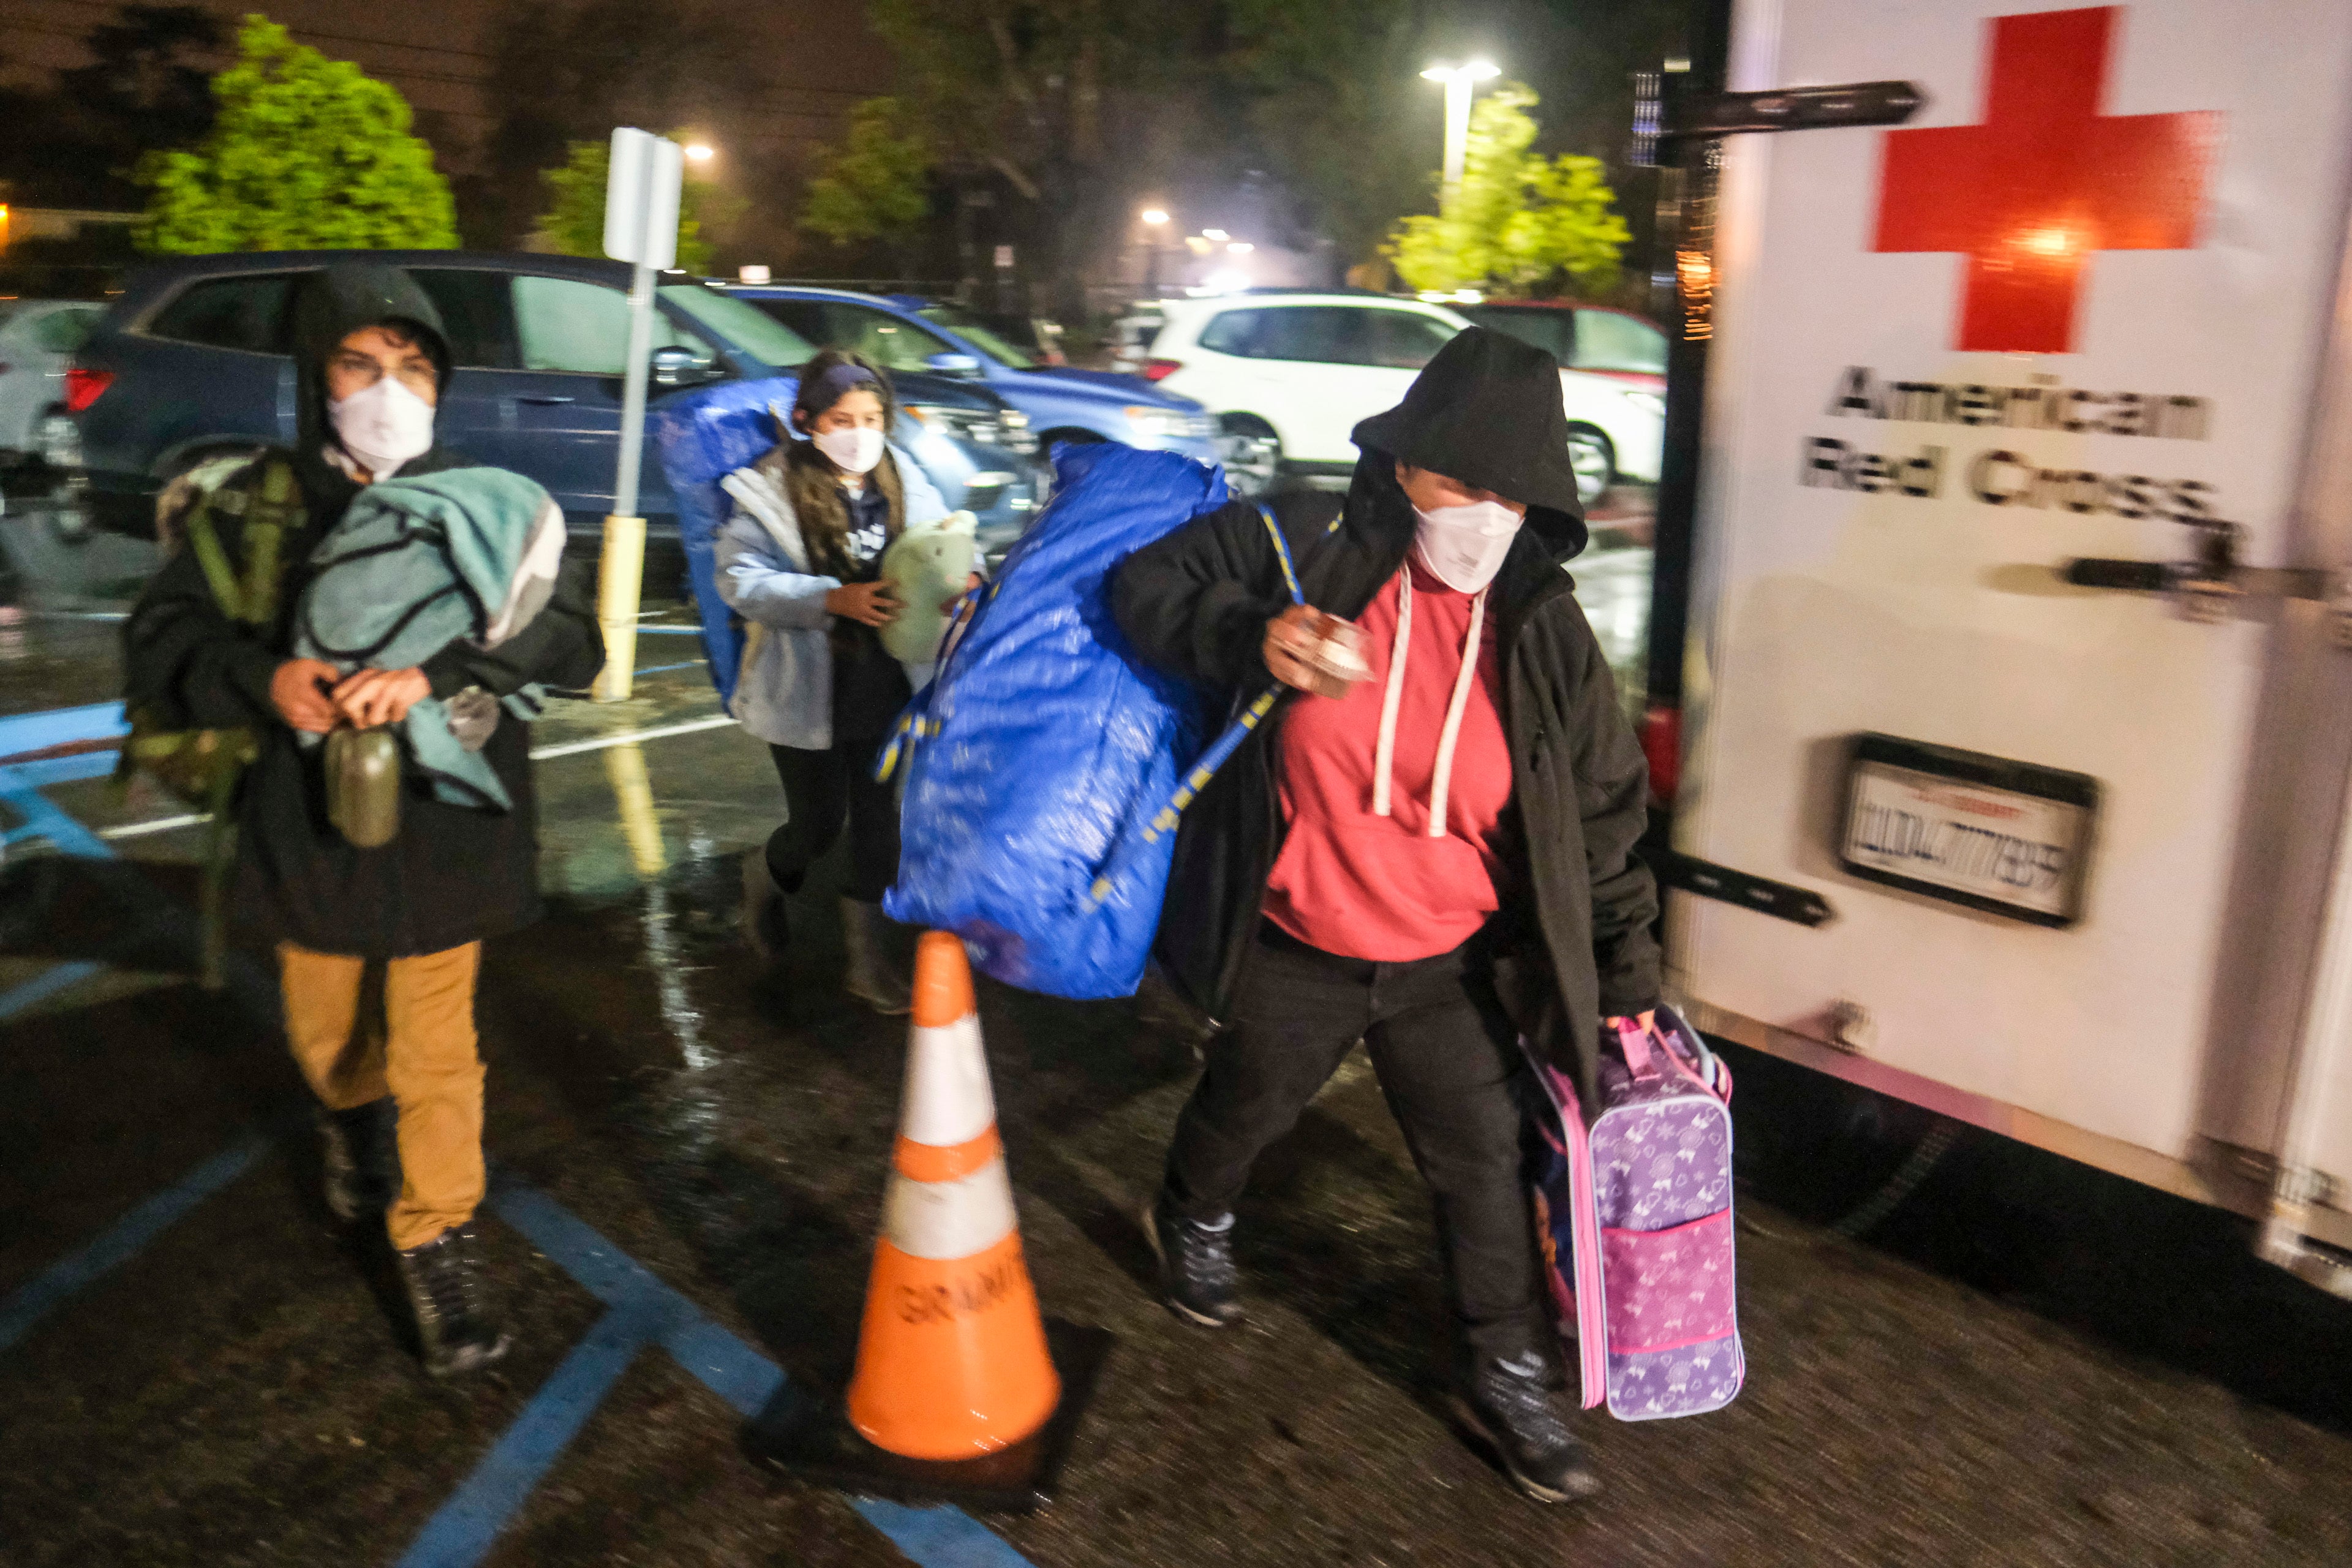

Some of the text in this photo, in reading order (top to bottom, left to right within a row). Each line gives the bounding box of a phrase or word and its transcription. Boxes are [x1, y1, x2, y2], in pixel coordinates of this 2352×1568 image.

[1829, 366, 2212, 440] American
[1800, 436, 2217, 524] Red Cross
